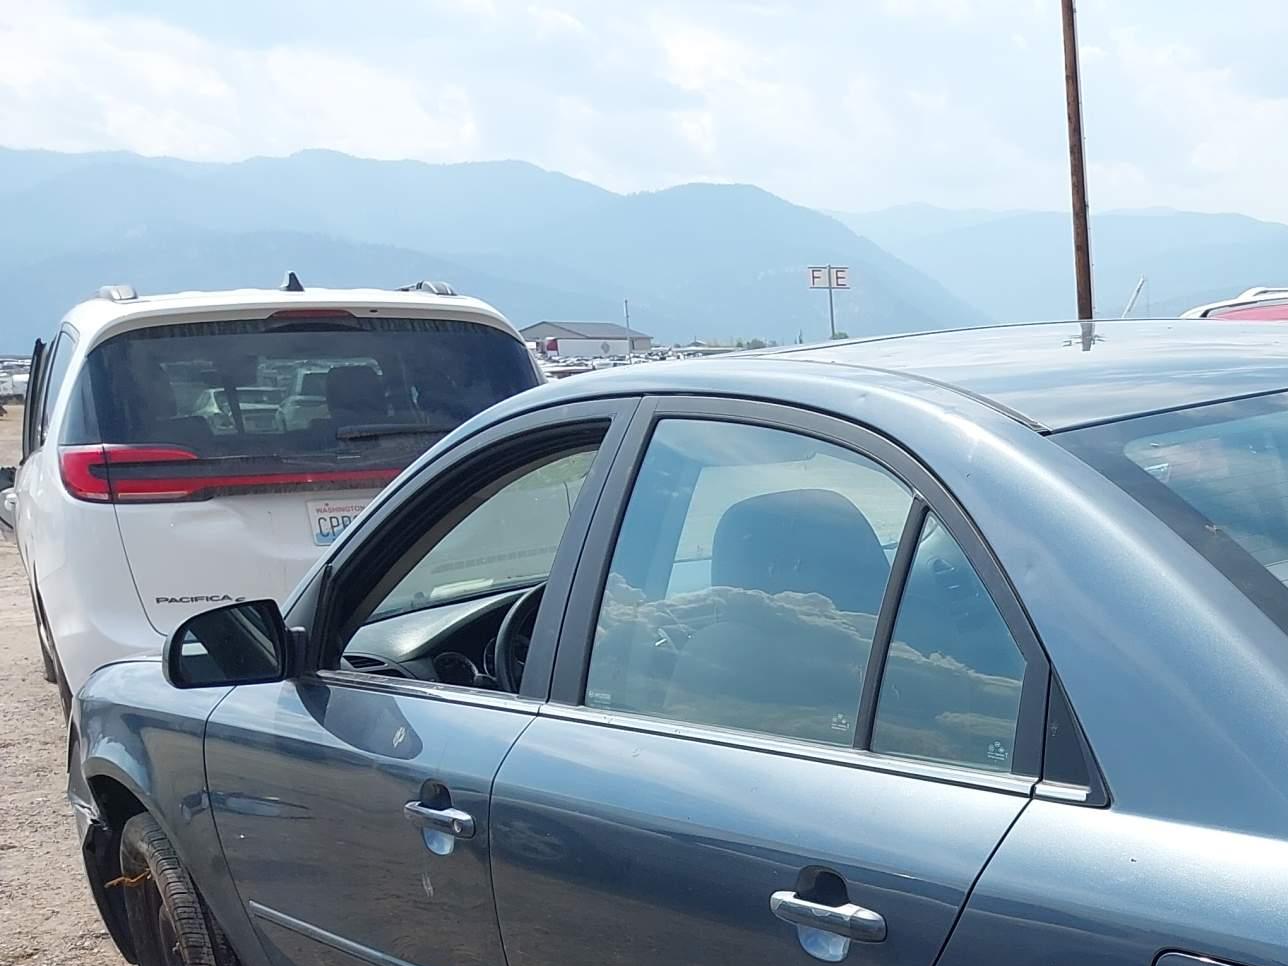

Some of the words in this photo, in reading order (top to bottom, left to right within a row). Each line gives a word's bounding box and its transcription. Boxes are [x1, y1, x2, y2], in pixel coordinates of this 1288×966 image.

[811, 269, 822, 286] F
[835, 269, 847, 287] E
[155, 594, 232, 604] PACIFICA
